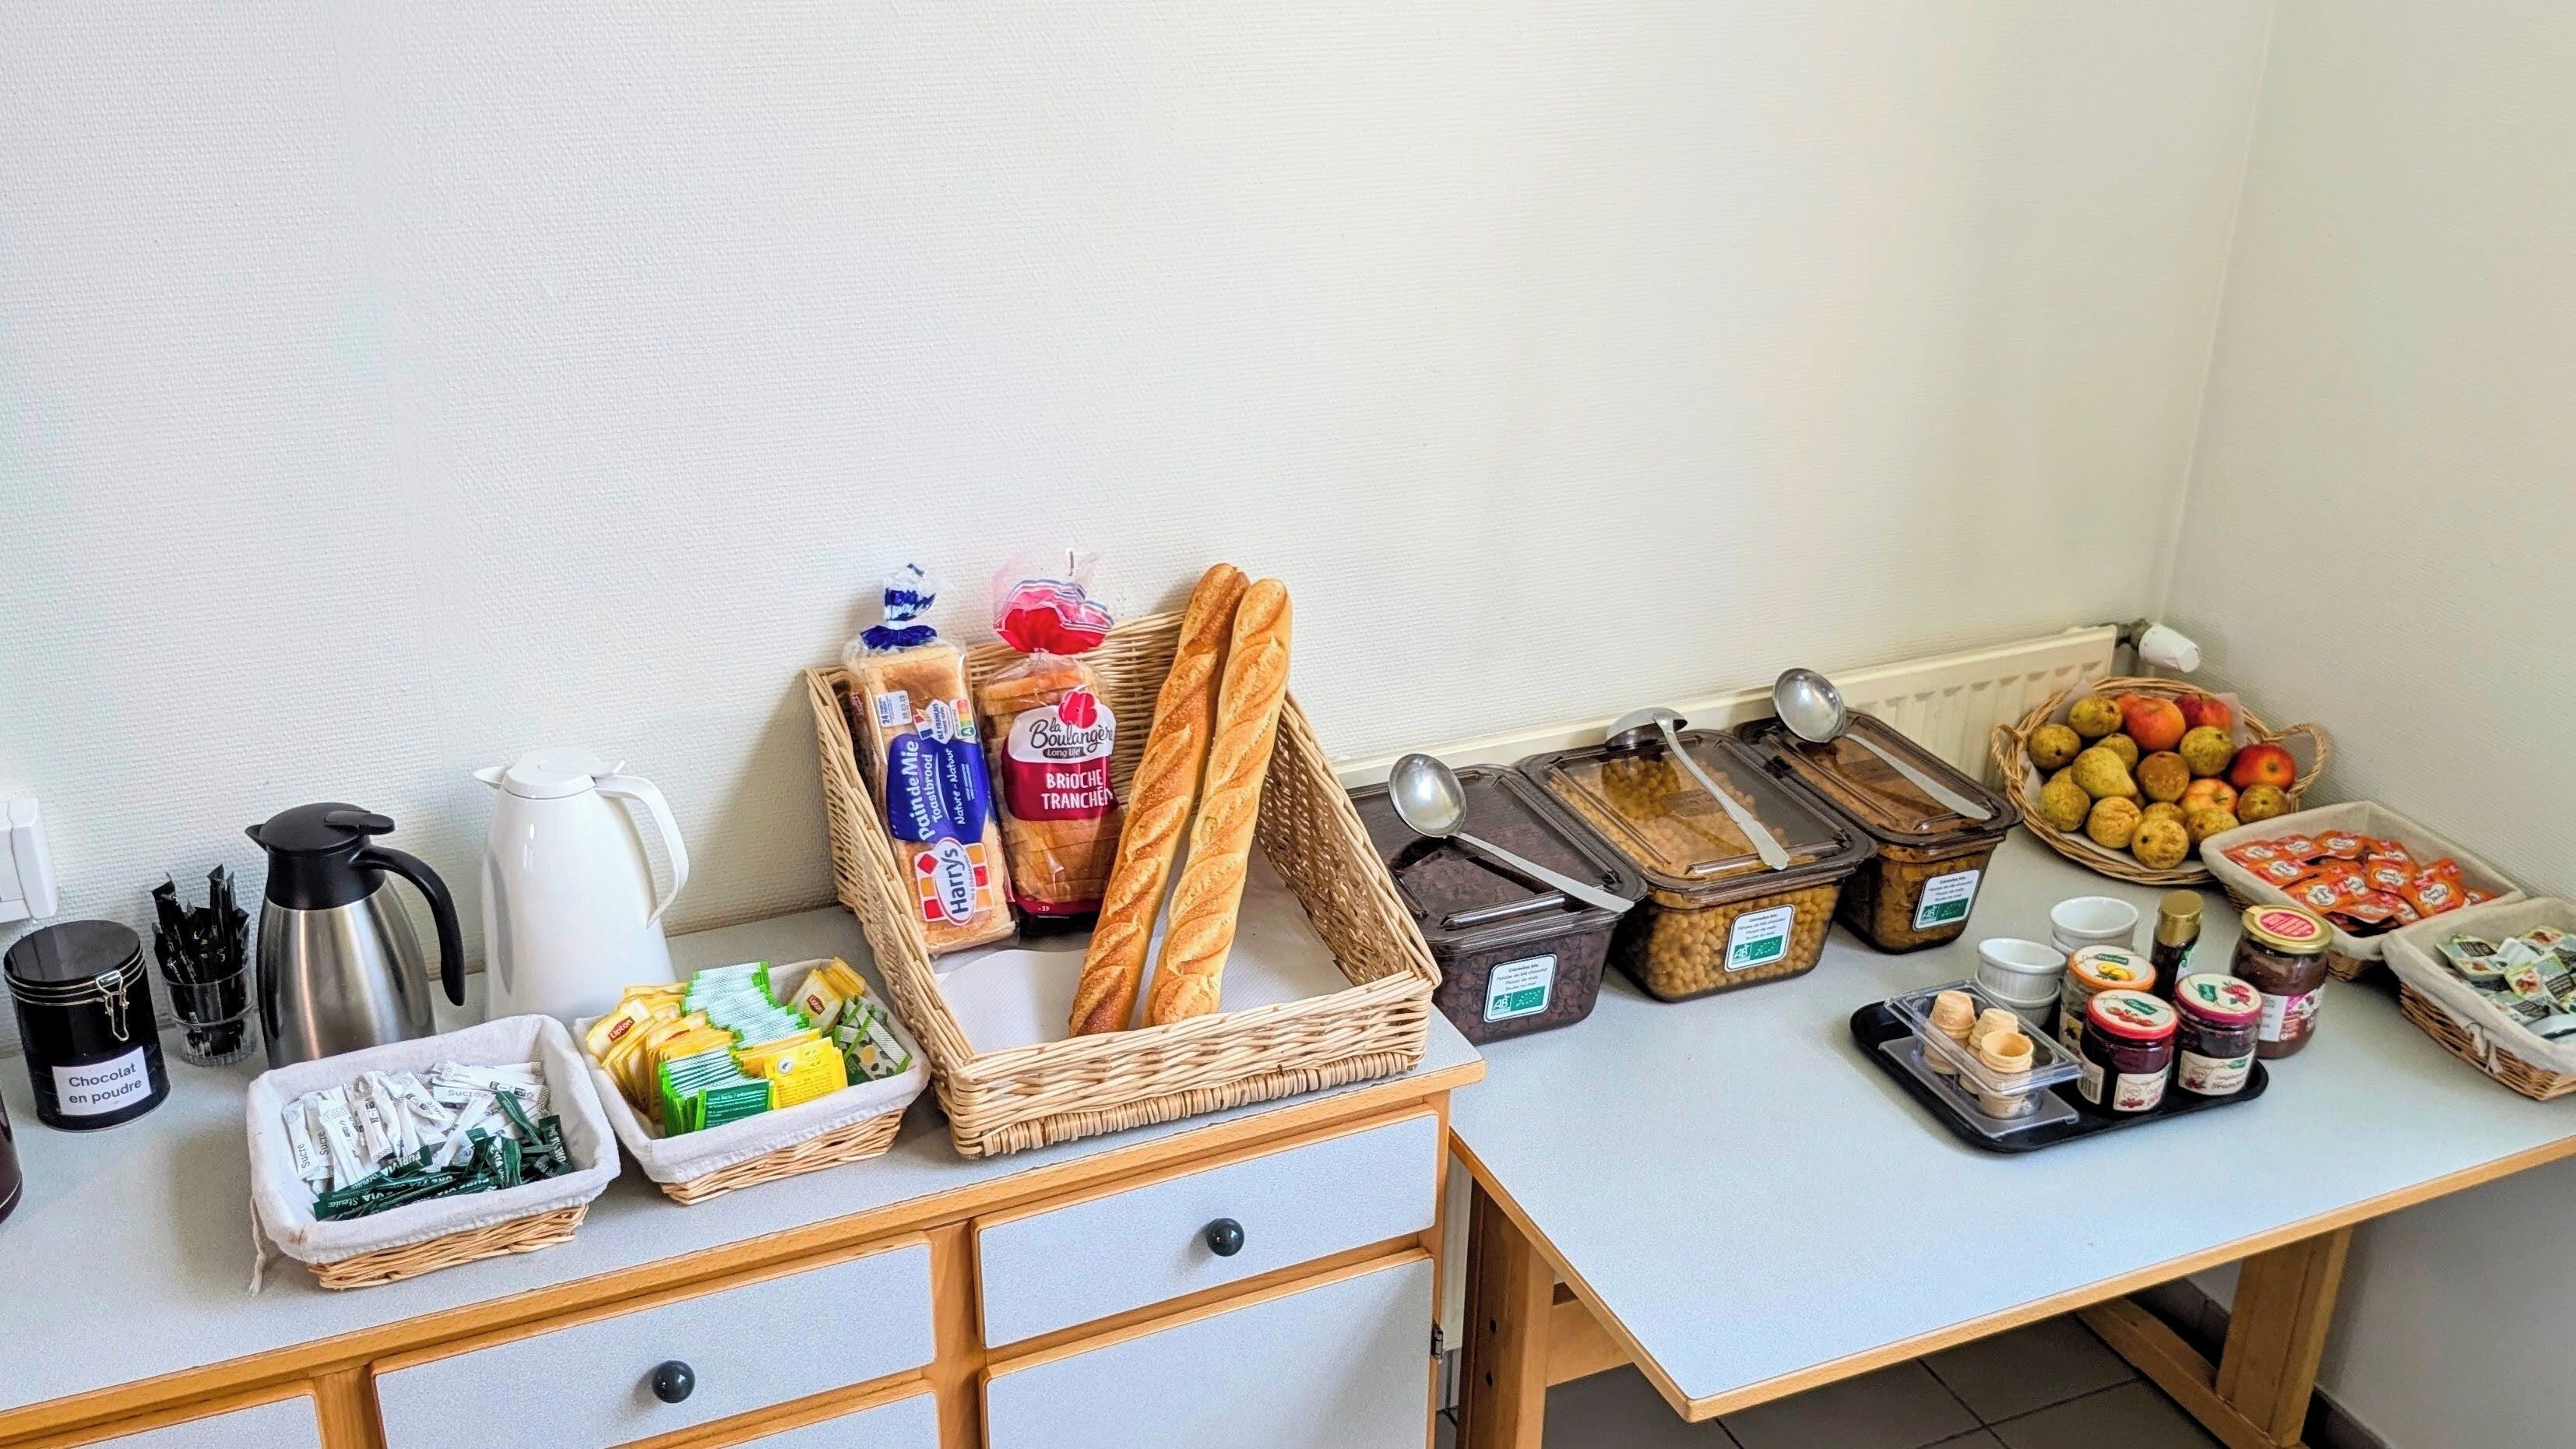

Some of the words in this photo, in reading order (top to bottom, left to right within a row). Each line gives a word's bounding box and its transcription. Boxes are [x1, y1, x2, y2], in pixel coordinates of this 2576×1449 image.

[1049, 716, 1061, 733] la
[899, 740, 920, 775] Mie
[1046, 747, 1068, 758] Long
[906, 777, 921, 797] de
[921, 754, 943, 823] Toastbrood
[910, 797, 935, 841] Pain
[953, 790, 966, 825] Nature
[941, 848, 969, 914] Harrys
[809, 996, 823, 1013] Lipton
[1494, 998, 1508, 1010] AB
[609, 1018, 632, 1039] Lipton
[69, 1063, 136, 1087] Chocolat
[69, 1094, 87, 1104] en
[91, 1079, 142, 1104] poudre
[318, 1131, 329, 1155] Sucre
[297, 1144, 310, 1169] Sucre
[328, 1197, 358, 1208] Stevia
[361, 1191, 385, 1202] VIA
